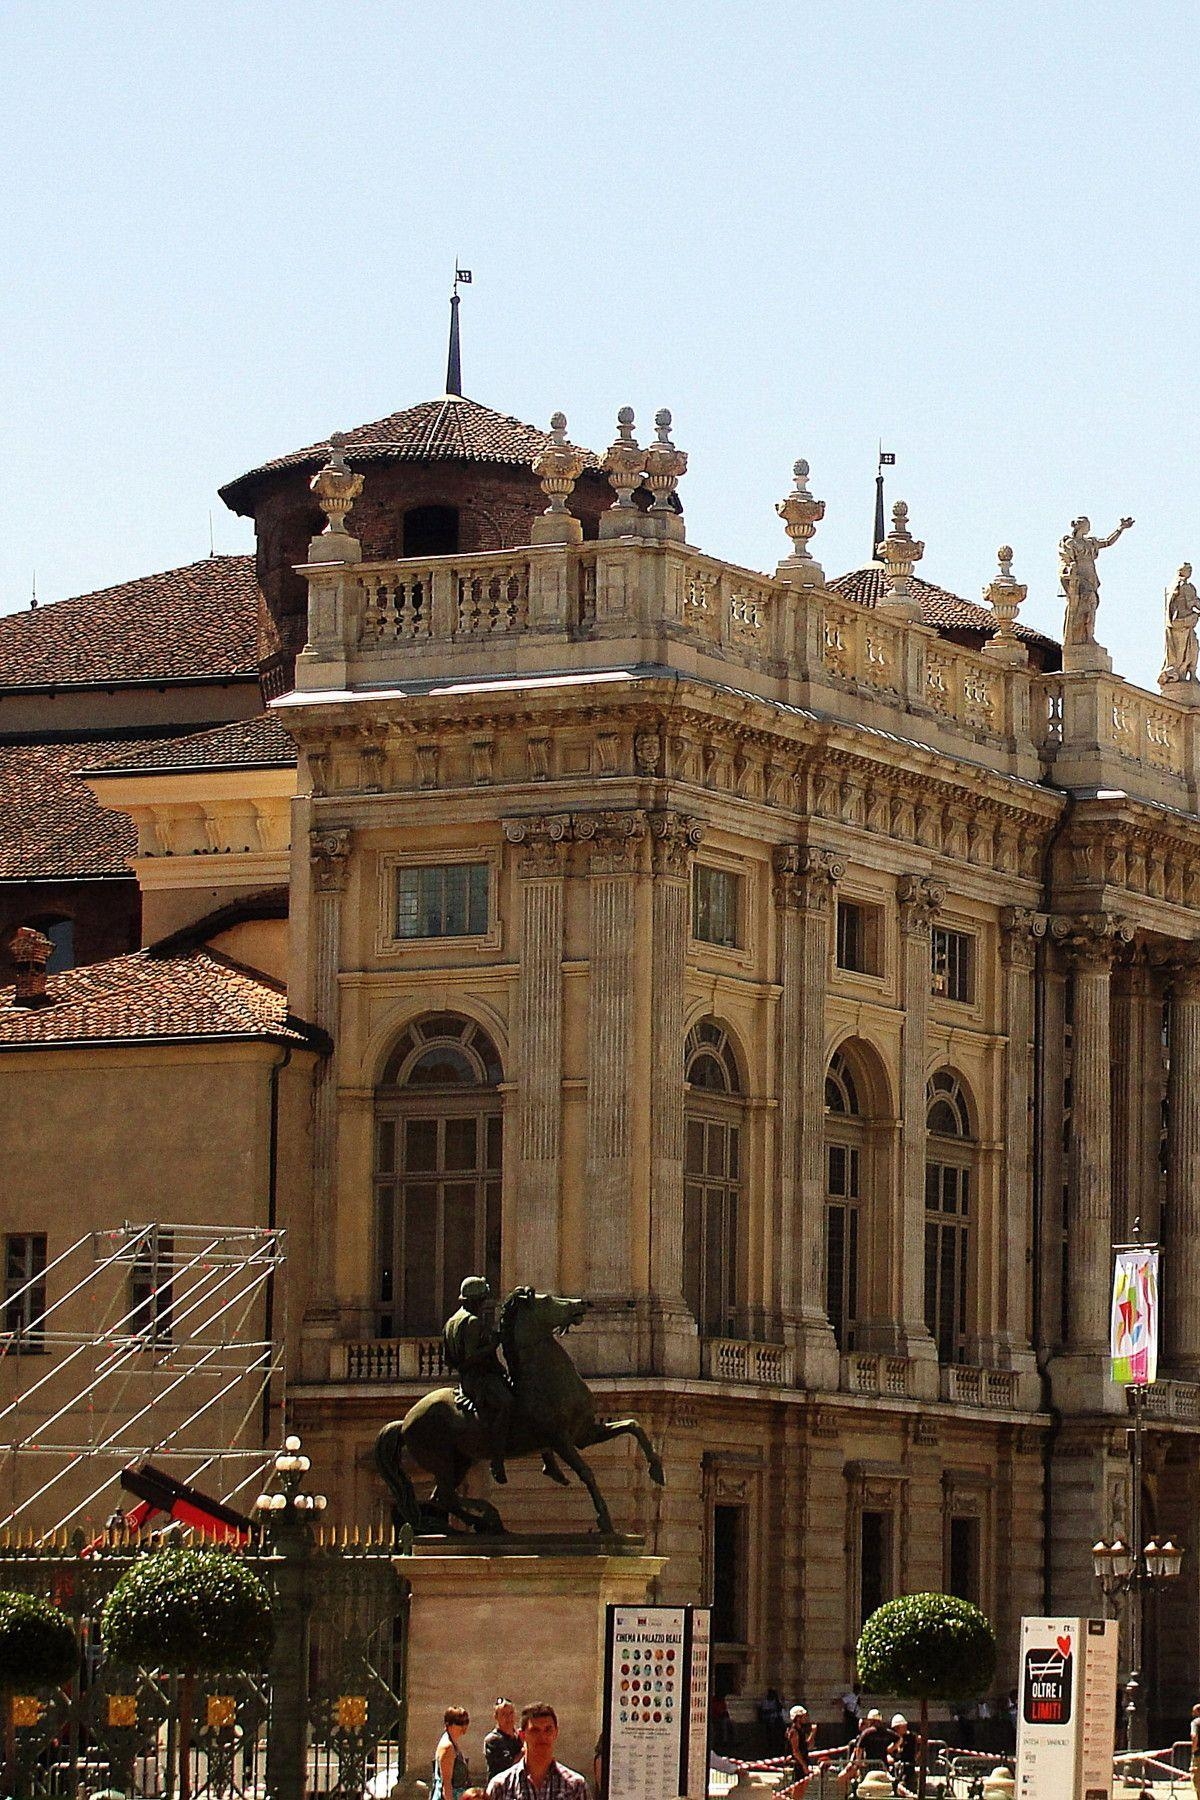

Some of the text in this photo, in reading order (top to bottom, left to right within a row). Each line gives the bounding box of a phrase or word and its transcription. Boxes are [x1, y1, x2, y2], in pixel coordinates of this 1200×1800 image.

[616, 1633, 635, 1642] CINEMA
[642, 1633, 665, 1643] PALAZZO
[666, 1633, 682, 1643] REALE
[1032, 1682, 1056, 1699] OLTRE
[1032, 1702, 1061, 1719] LIMITI
